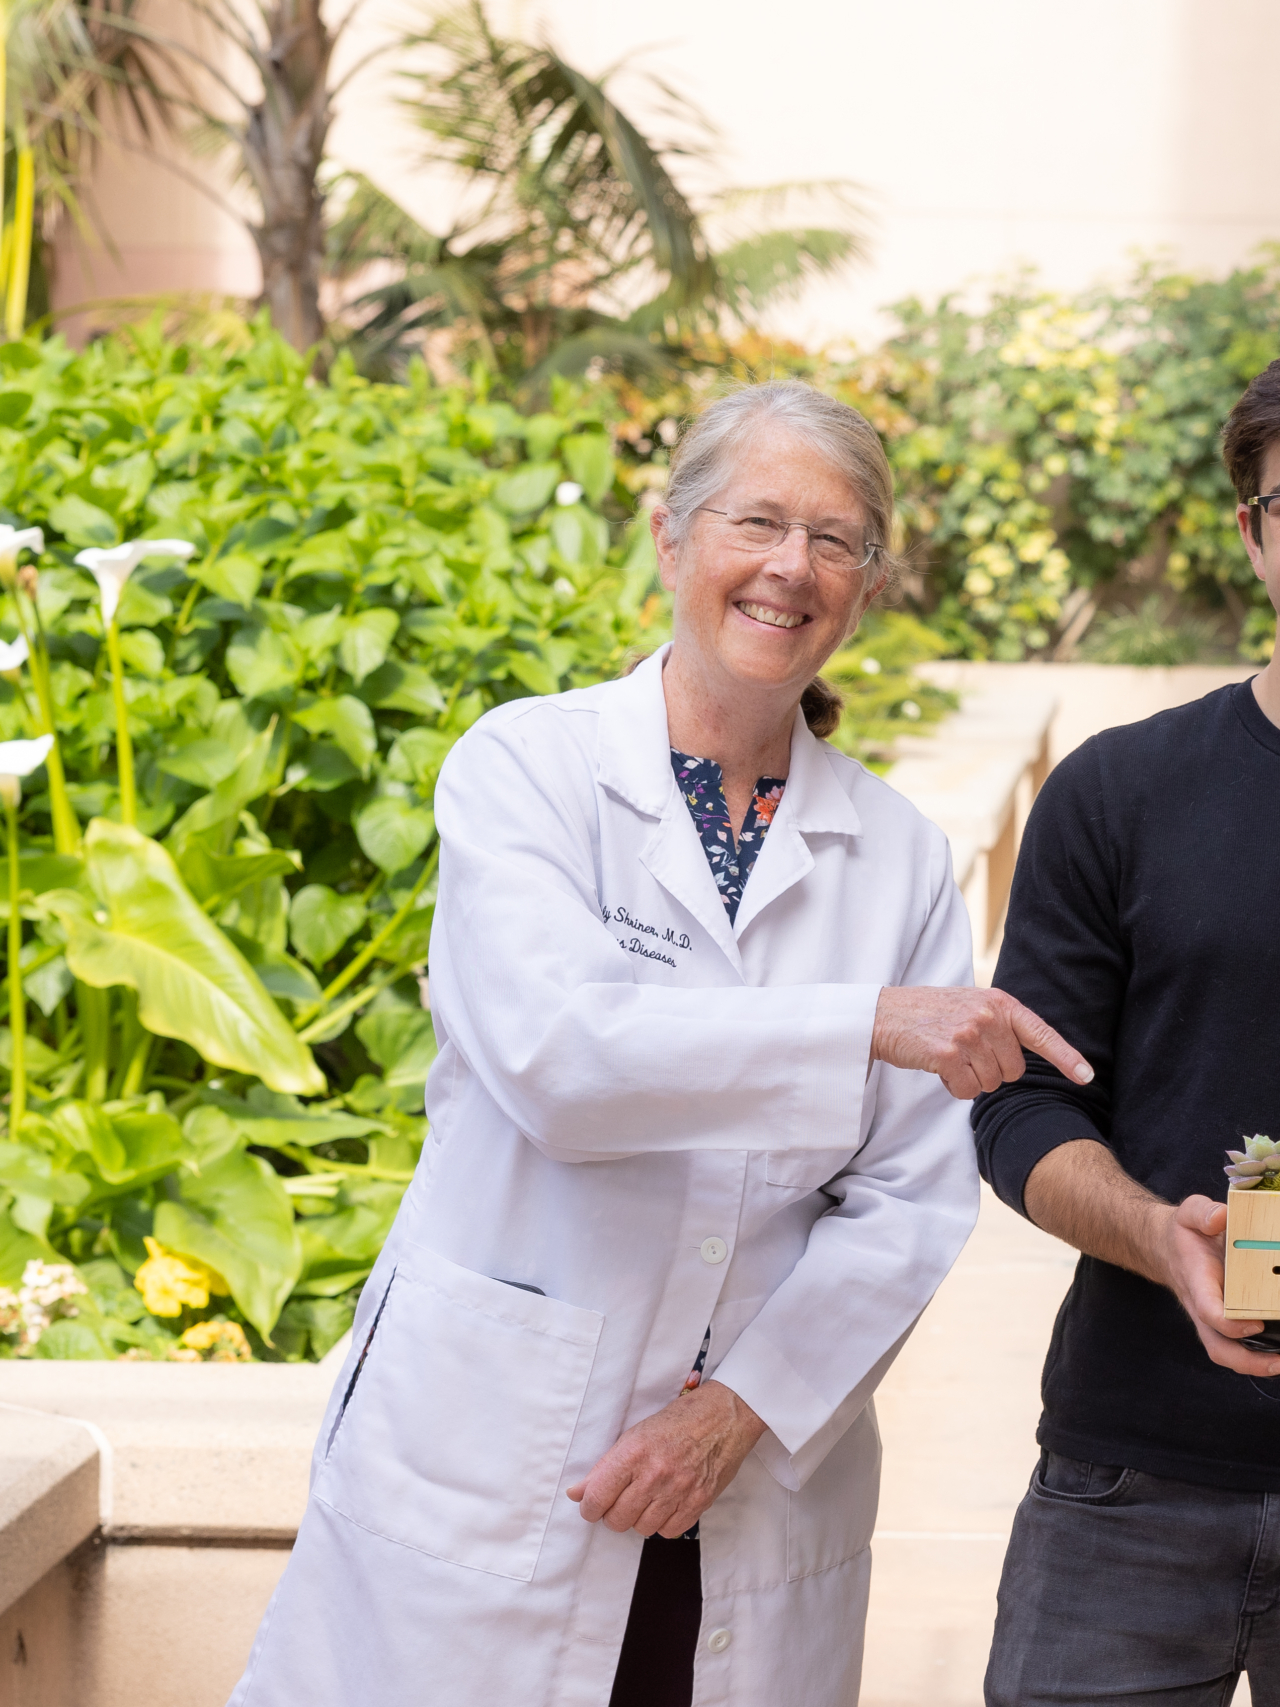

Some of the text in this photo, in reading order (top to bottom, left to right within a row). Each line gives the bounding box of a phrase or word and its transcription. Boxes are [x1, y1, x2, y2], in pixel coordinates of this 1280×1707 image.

[614, 906, 659, 938] Shriner,
[661, 927, 693, 951] M.D.
[628, 937, 677, 968] Diseases
